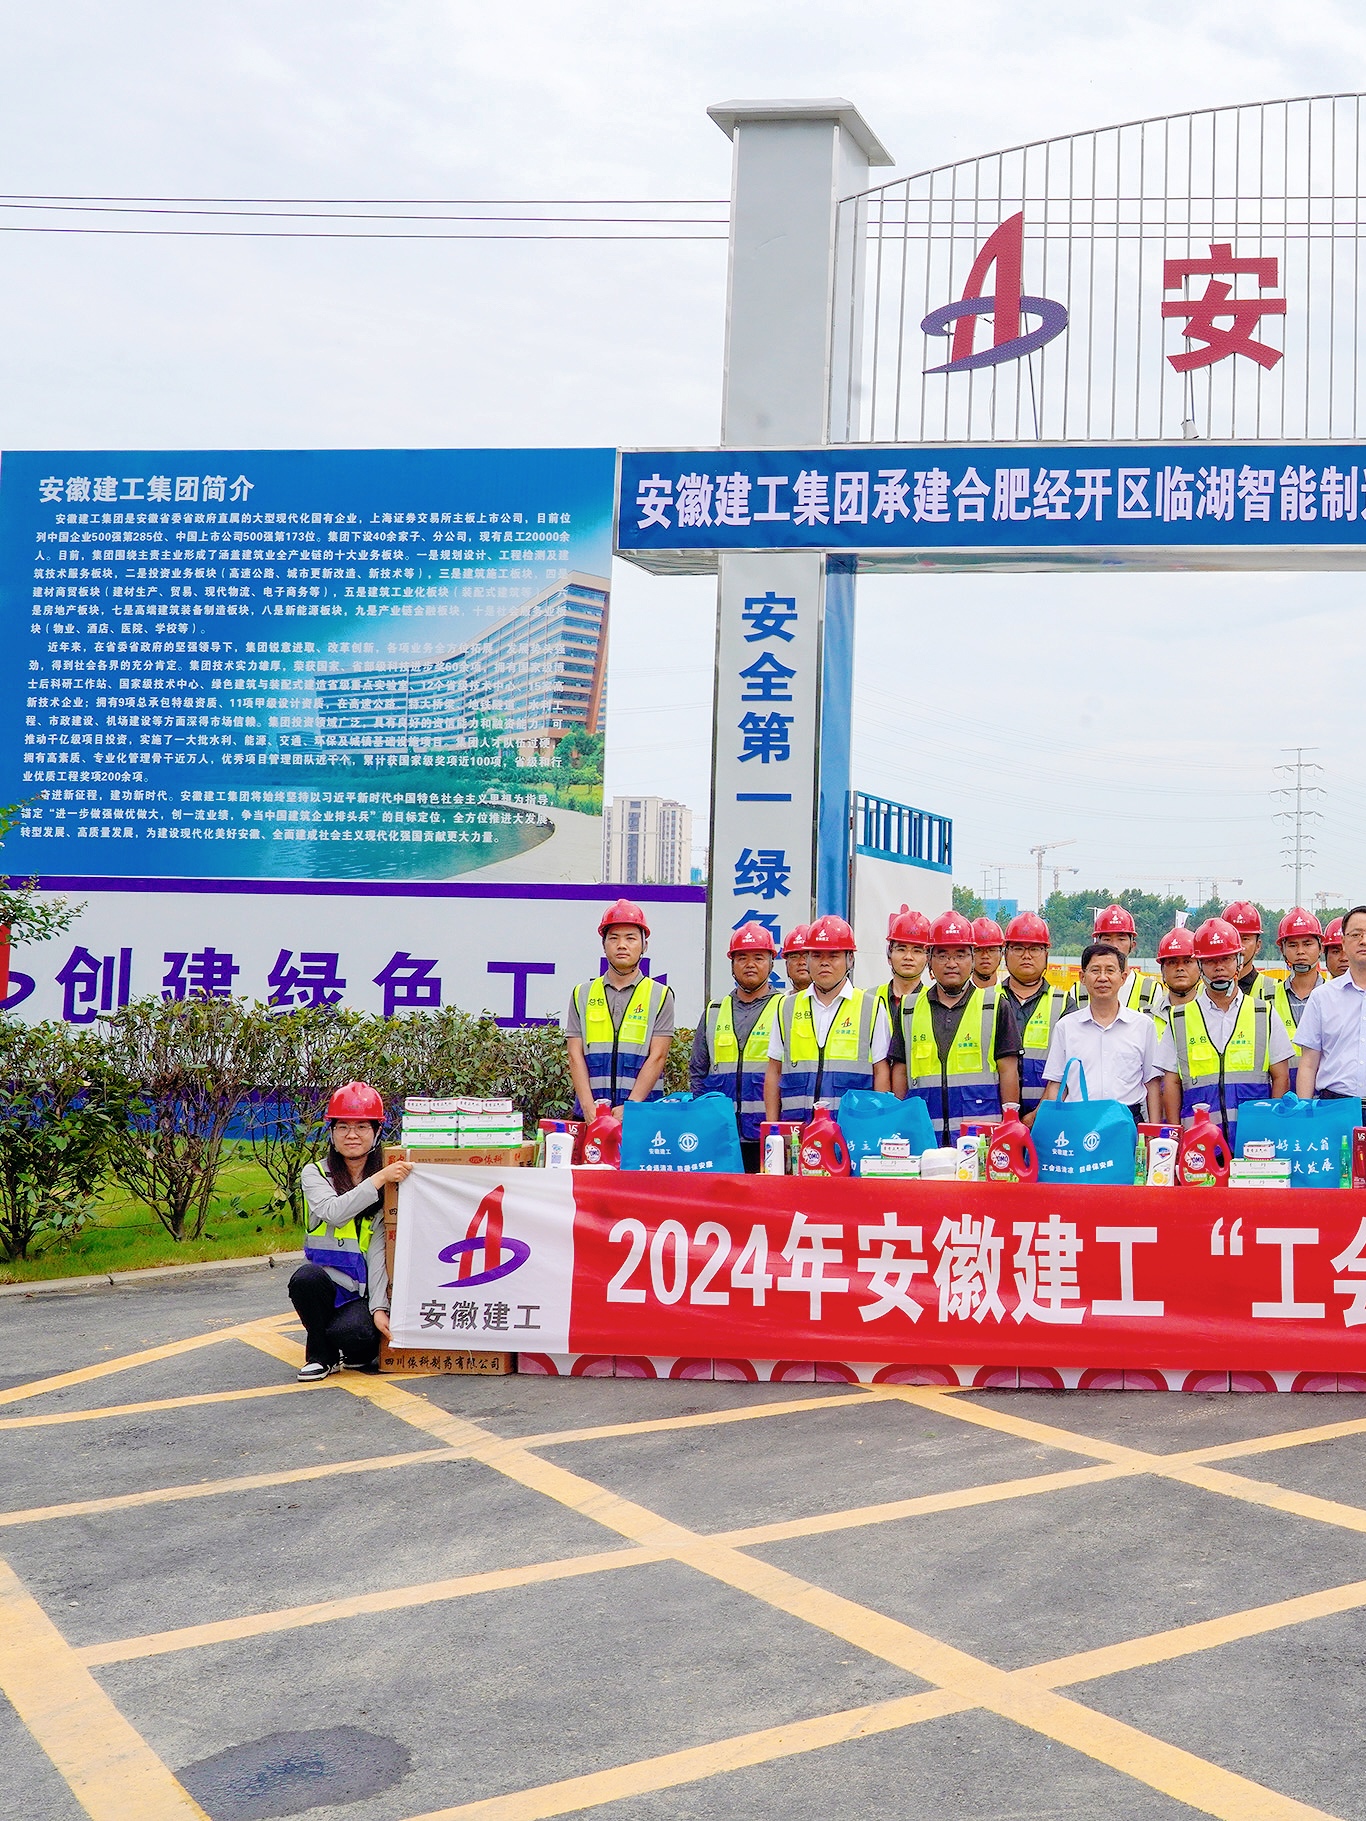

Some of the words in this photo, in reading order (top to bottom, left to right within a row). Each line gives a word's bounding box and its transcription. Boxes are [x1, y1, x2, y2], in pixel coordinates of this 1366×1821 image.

[38, 475, 255, 503] 安徽建工集团简介
[30, 622, 206, 635] 块（物业、酒店、医院、学校等）。
[736, 592, 798, 801] 安全第一
[22, 770, 149, 783] 业优质工程奖项200余项。
[55, 946, 672, 1028] 创建绿色工
[606, 1211, 1165, 1326] 2024年安徽建工
[419, 1299, 541, 1331] 安徽建工
